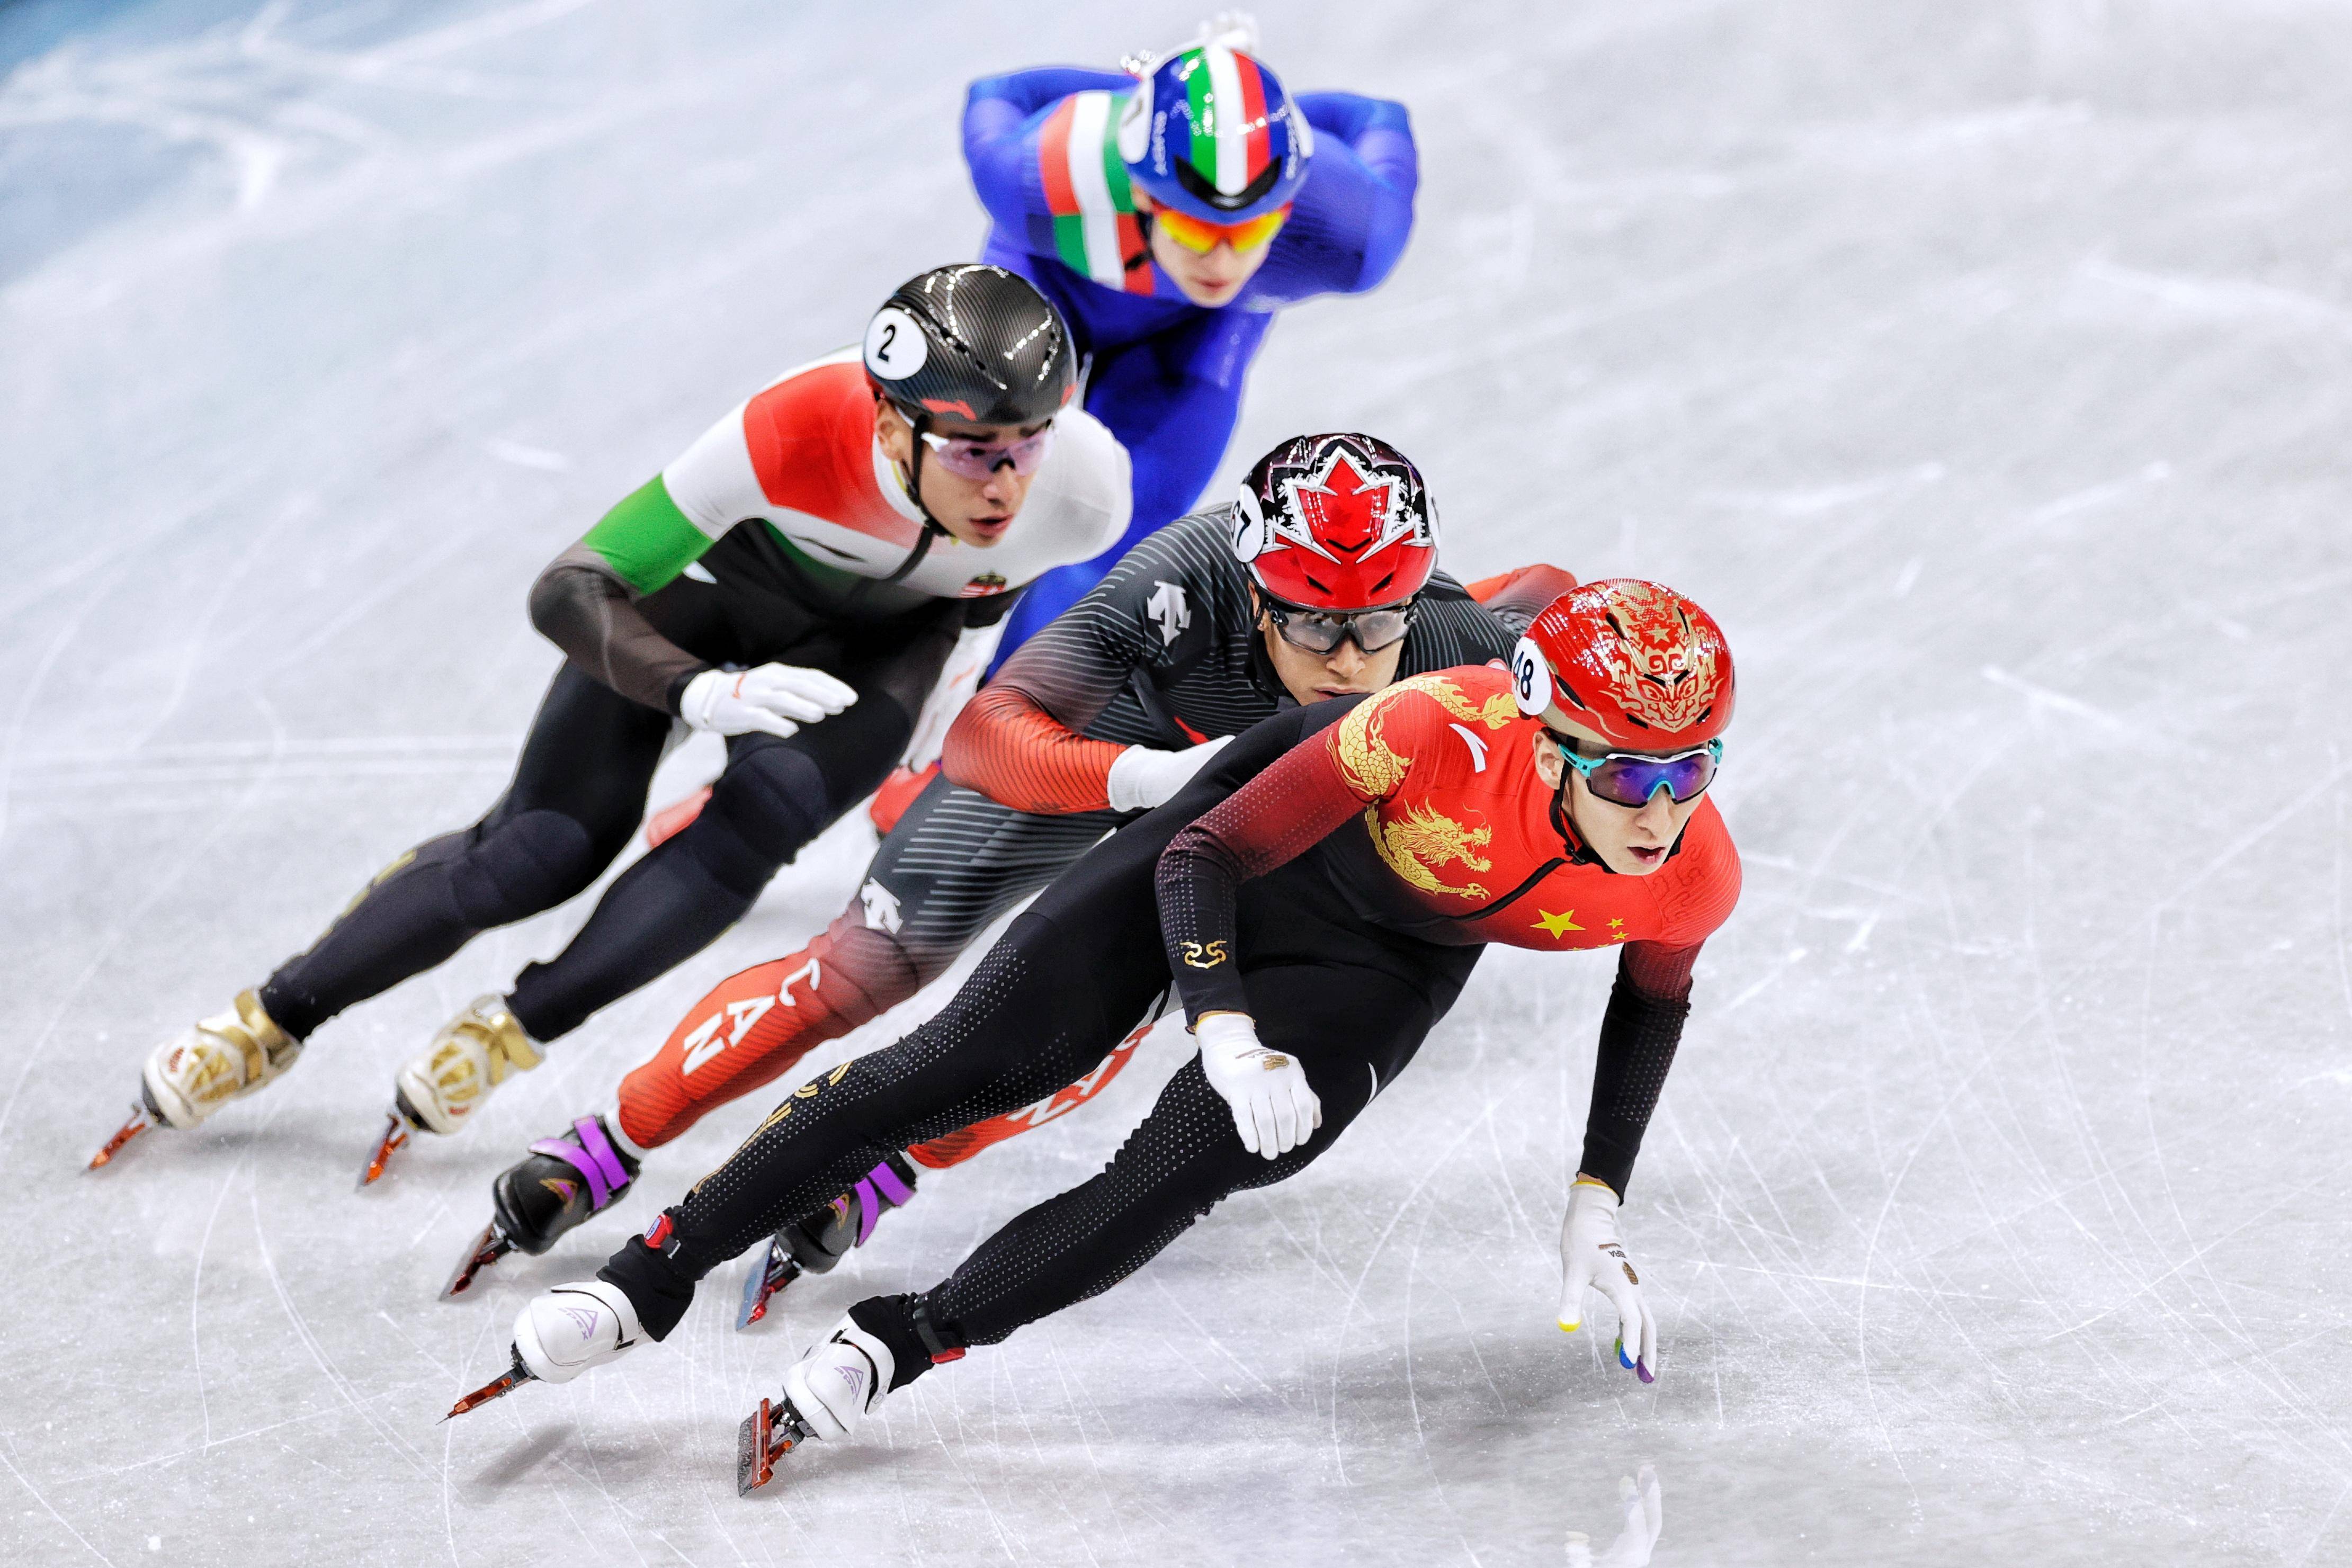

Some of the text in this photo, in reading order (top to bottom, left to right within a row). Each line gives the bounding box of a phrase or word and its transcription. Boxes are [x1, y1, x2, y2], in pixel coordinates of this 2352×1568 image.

[878, 324, 896, 363] 2
[1513, 651, 1534, 701] 48
[682, 957, 820, 1076] CAN
